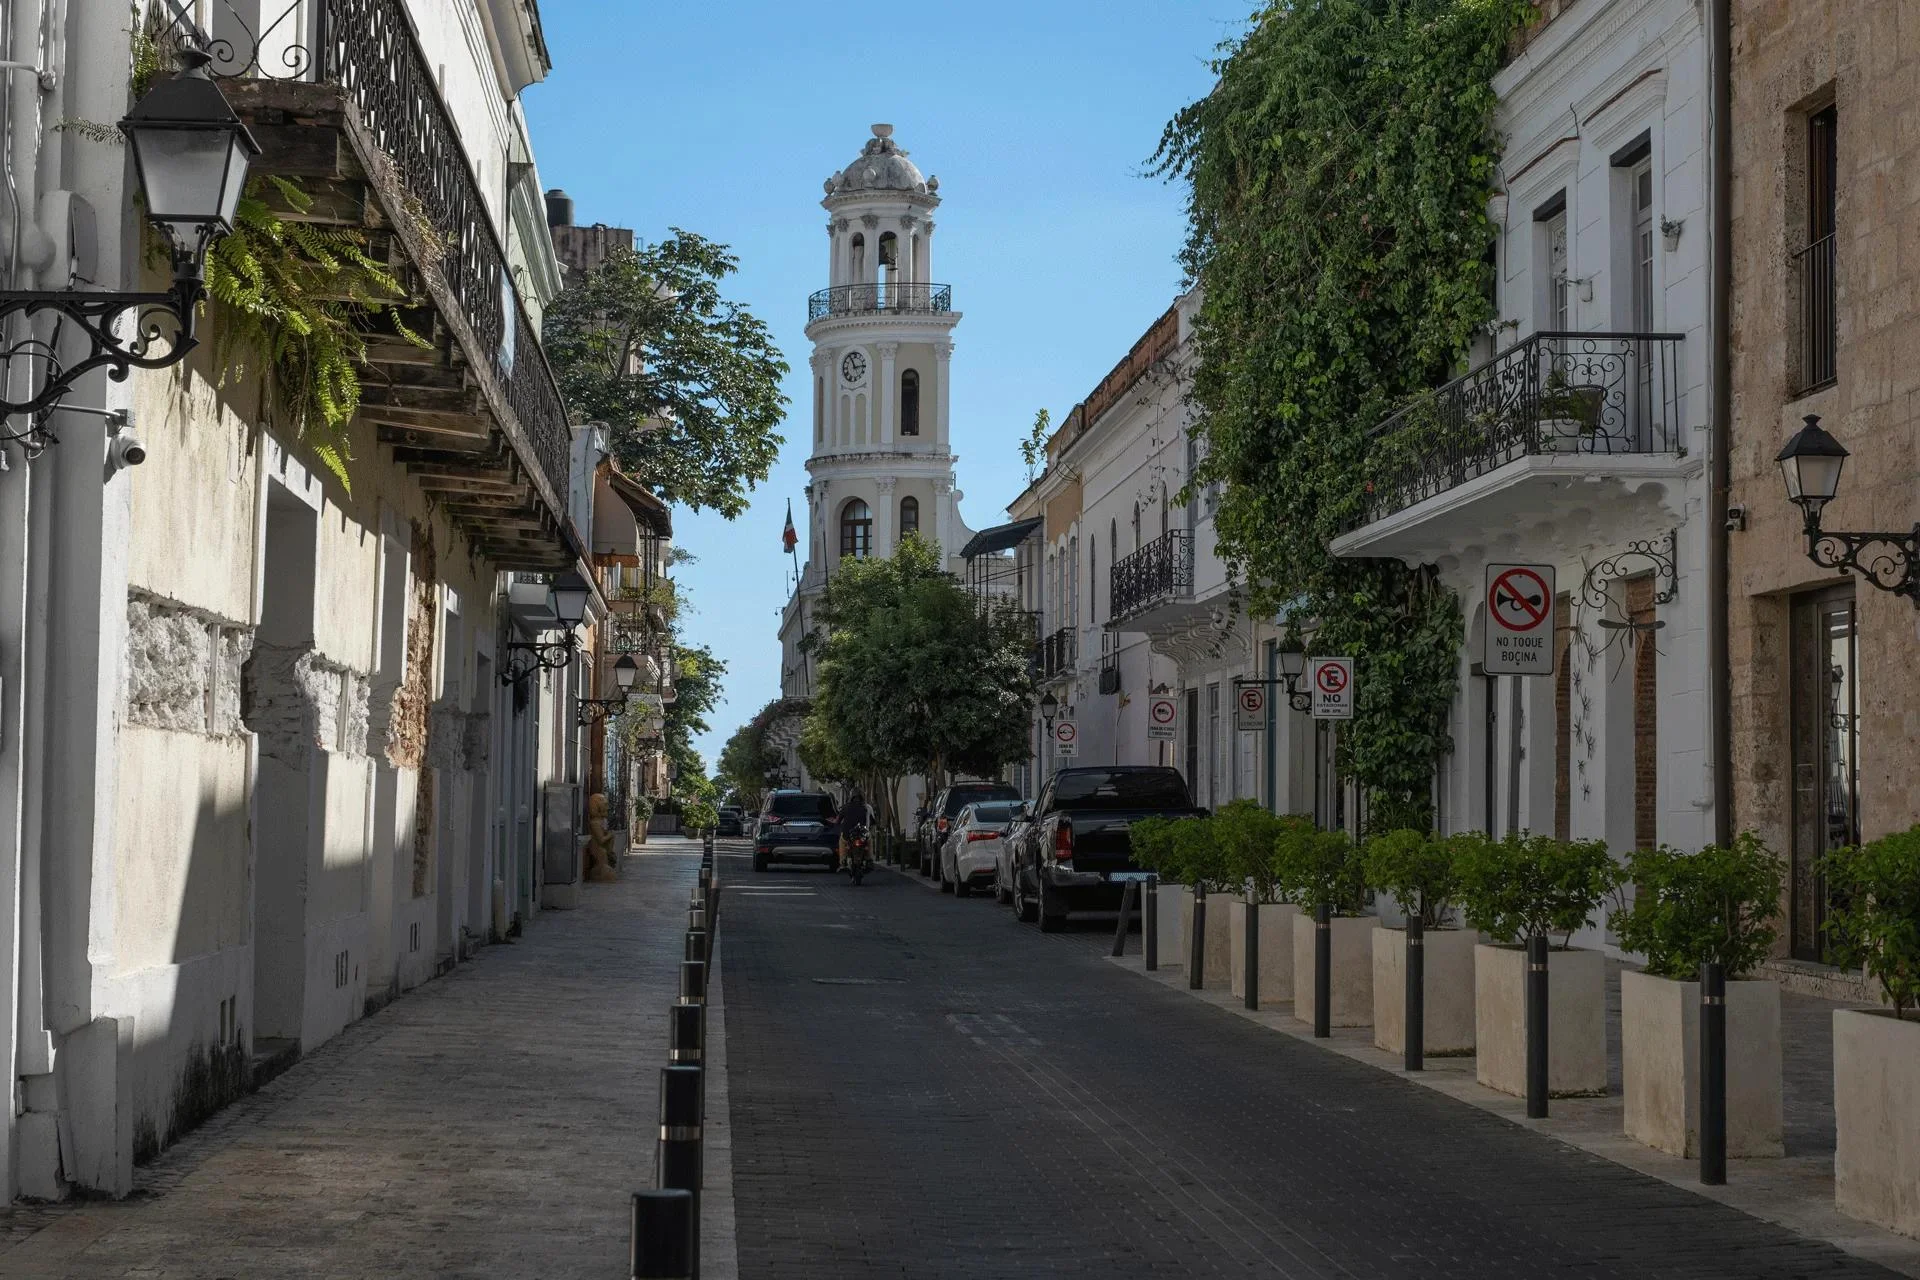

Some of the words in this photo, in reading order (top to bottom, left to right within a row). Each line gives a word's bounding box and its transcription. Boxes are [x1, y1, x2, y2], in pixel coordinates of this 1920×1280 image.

[1496, 637, 1509, 647] NO
[1513, 637, 1543, 648] TOQUE
[1501, 651, 1538, 662] BOCINA
[1323, 694, 1341, 703] NO
